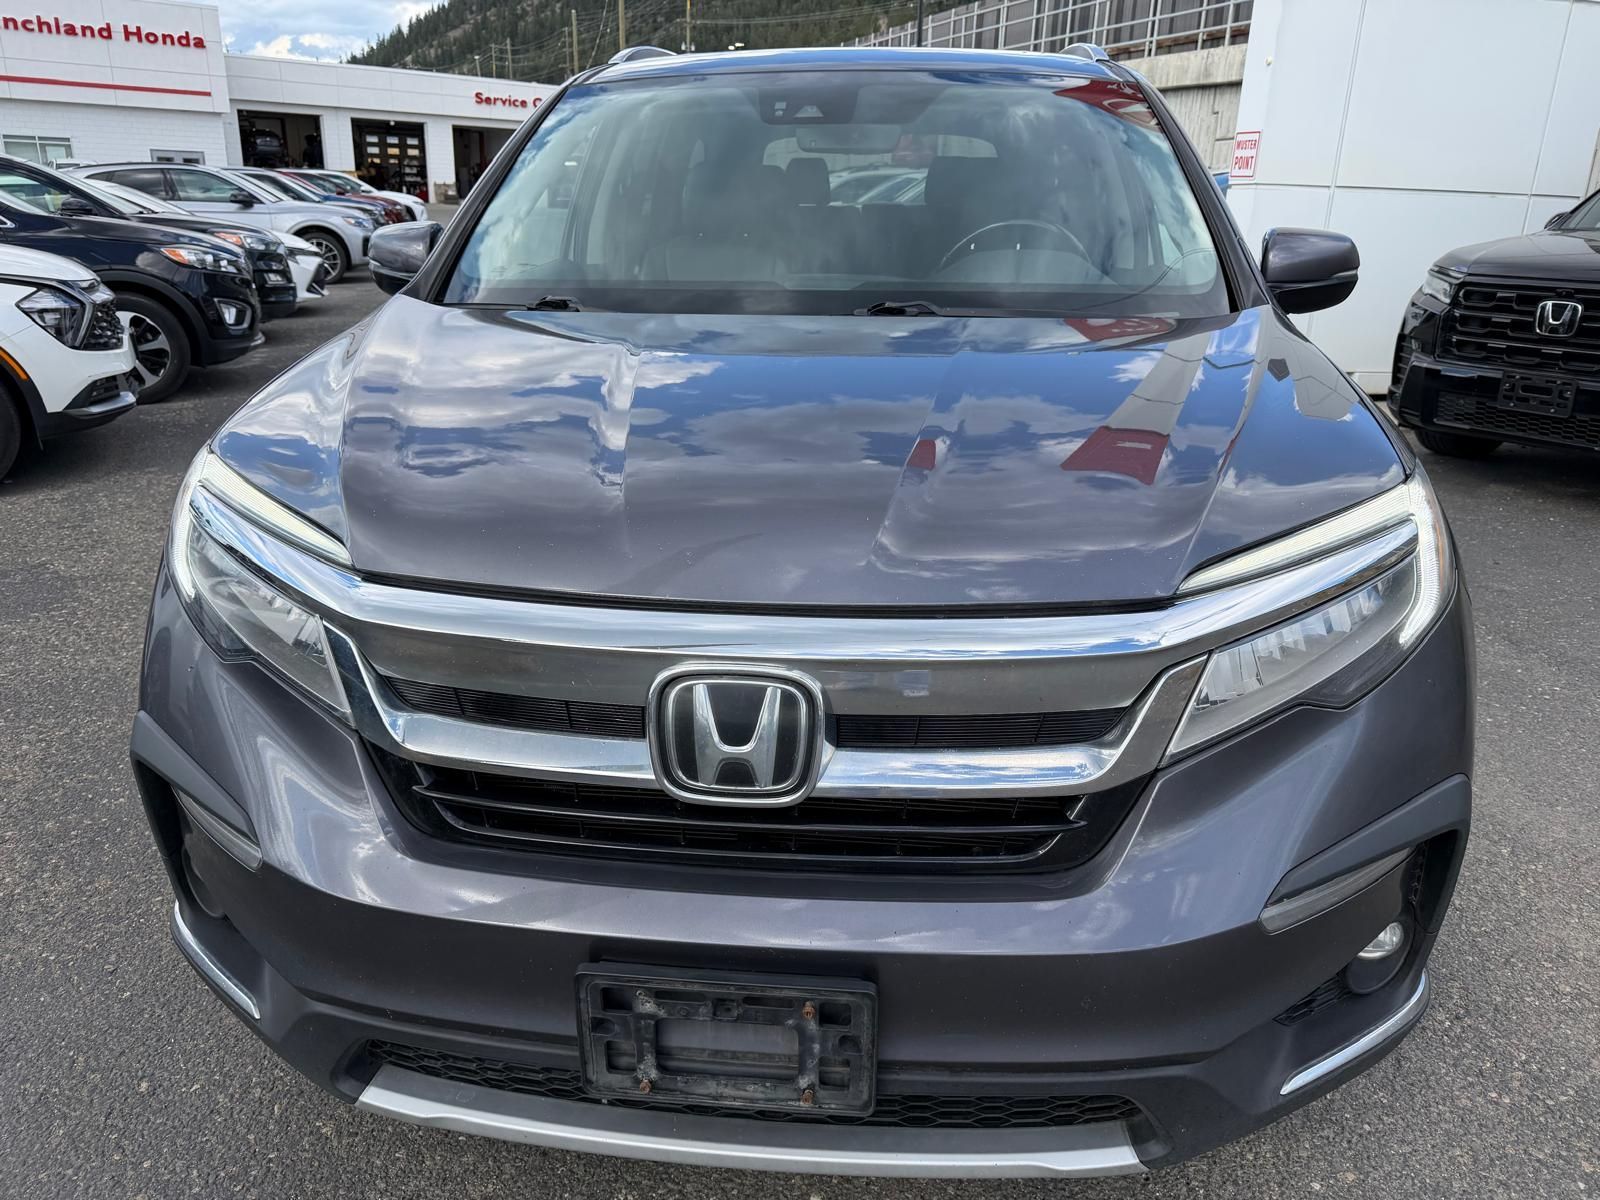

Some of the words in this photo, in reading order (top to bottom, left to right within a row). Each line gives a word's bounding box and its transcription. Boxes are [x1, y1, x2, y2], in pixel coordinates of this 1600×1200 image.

[0, 15, 112, 40] nchland
[122, 24, 206, 49] Honda
[475, 92, 528, 108] Service
[1236, 139, 1257, 150] MUSTER
[1233, 156, 1254, 170] POINT
